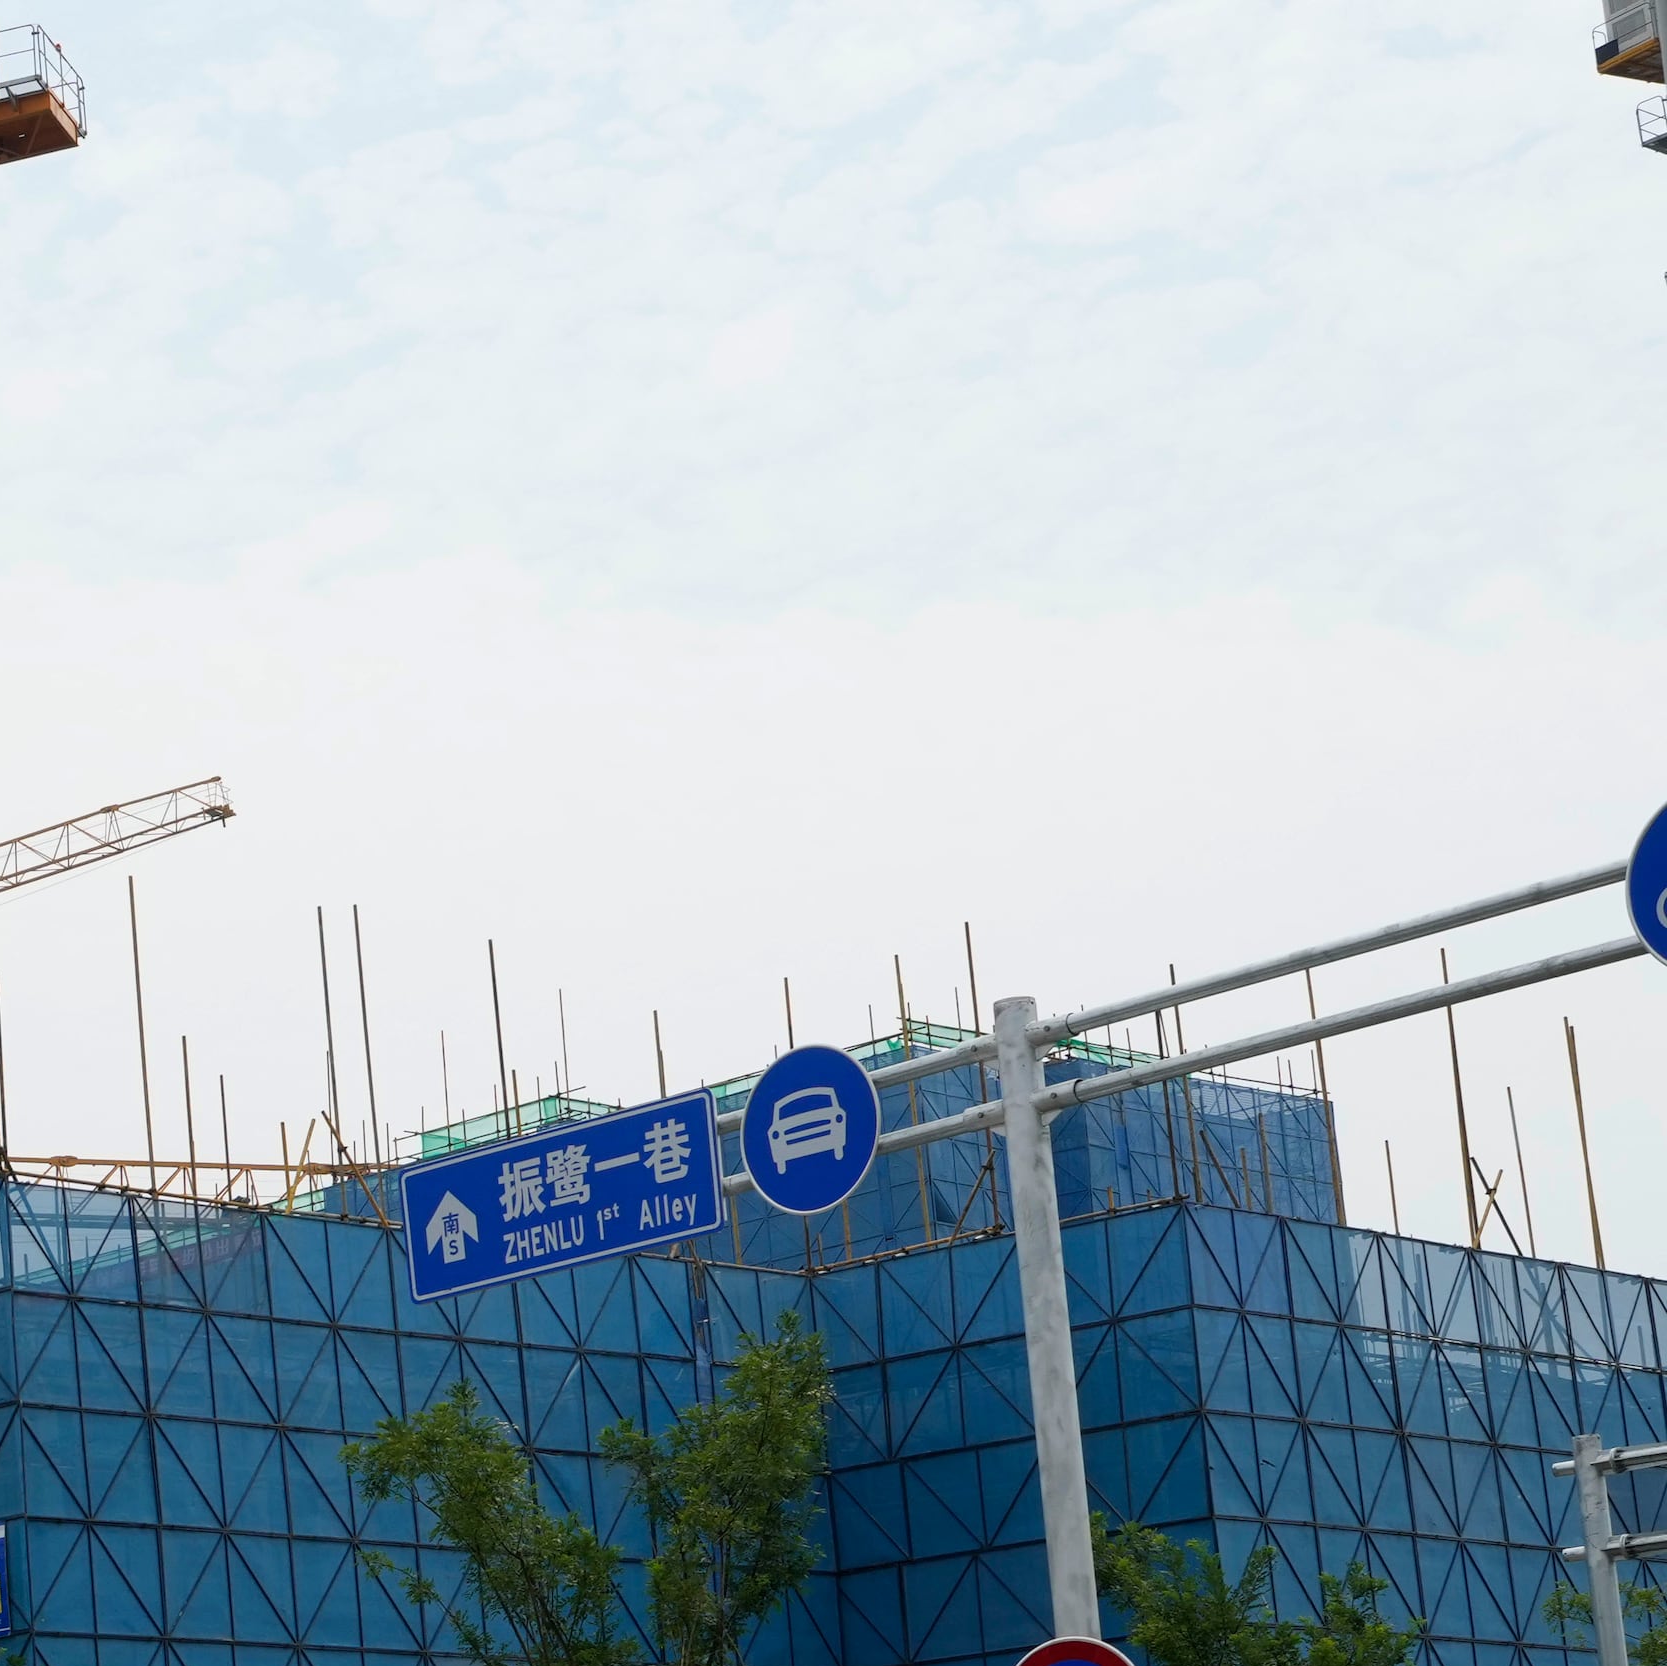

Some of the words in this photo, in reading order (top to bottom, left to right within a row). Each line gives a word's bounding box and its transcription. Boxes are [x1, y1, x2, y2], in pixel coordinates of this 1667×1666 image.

[497, 1119, 691, 1222] 振鹭一巷
[441, 1212, 459, 1237] 南
[449, 1240, 458, 1255] S
[503, 1215, 584, 1264] ZHENLU
[596, 1203, 620, 1240] 1st
[639, 1193, 697, 1230] Alley
